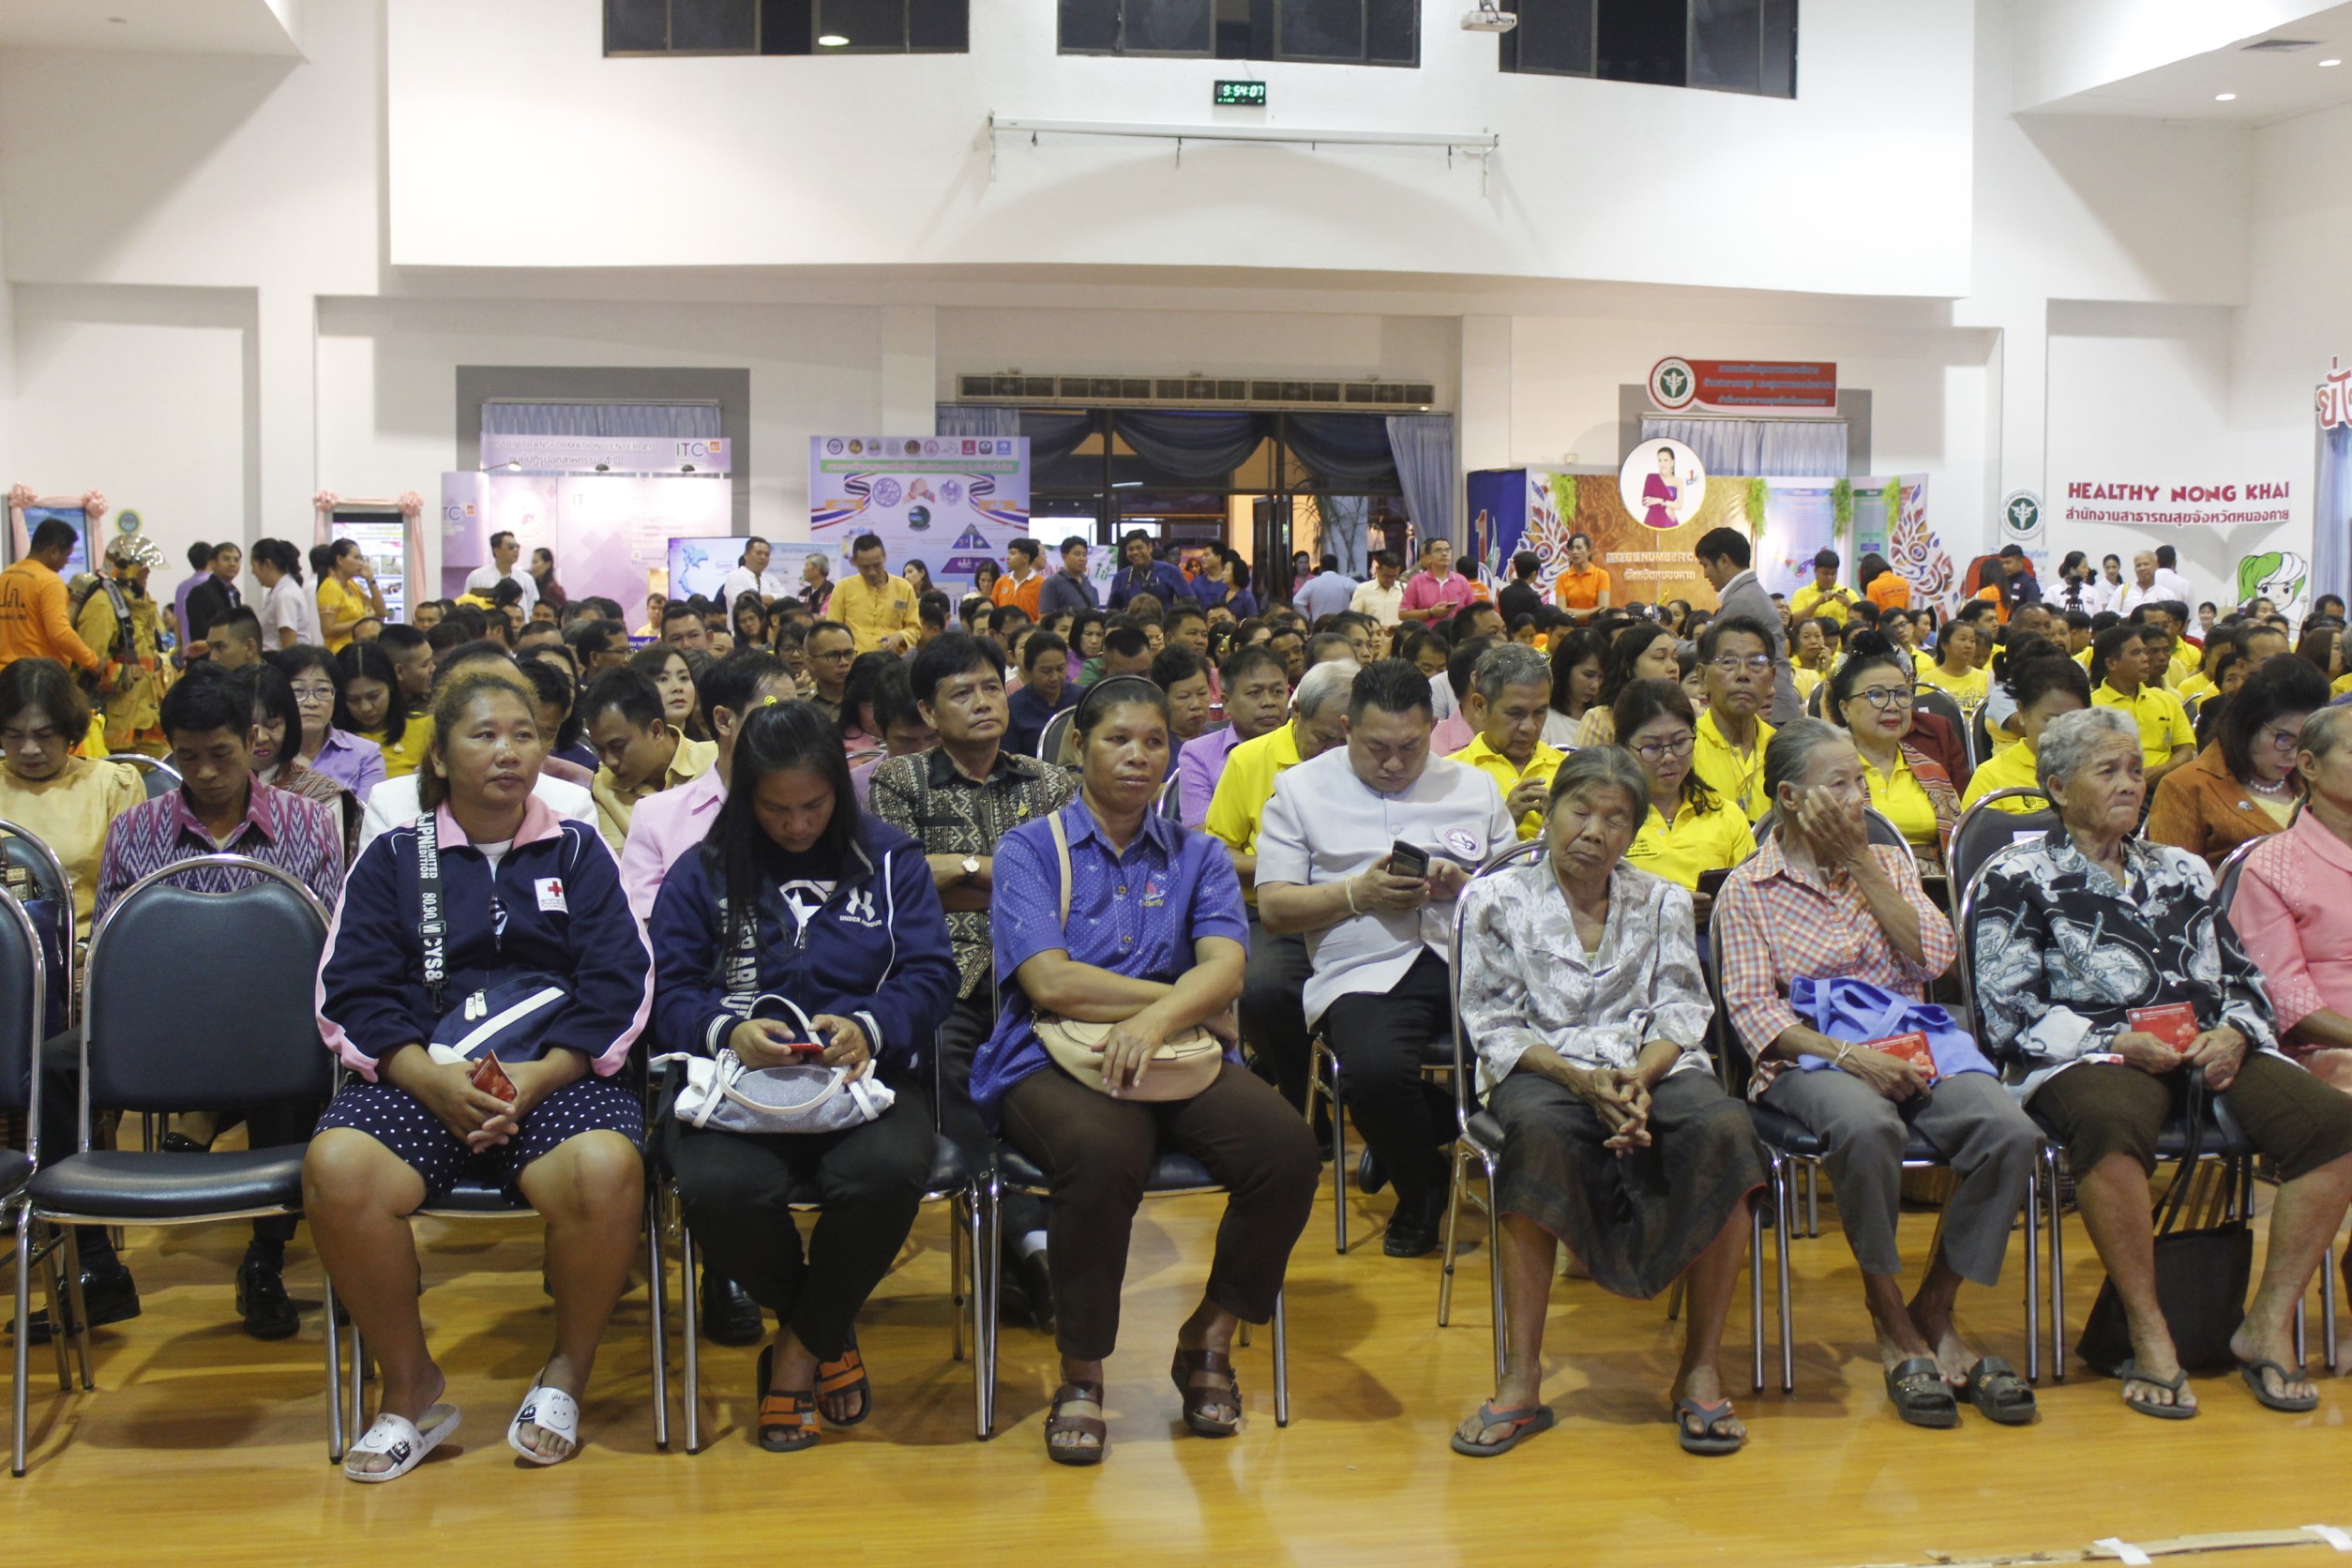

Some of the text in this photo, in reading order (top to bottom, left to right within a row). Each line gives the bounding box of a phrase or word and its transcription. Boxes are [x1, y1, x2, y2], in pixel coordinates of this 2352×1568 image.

[676, 442, 704, 457] ITC
[2068, 481, 2290, 502] HEALTHY NONG KHAI
[2066, 506, 2289, 526] สำนักงานสาธารณสุขจังหวัดหนองคาย
[1626, 553, 1640, 563] BE
[1641, 553, 1685, 563] NUMBER
[418, 845, 430, 879] EDITION
[428, 845, 438, 879] LIMITED
[861, 918, 882, 927] ARMOUR
